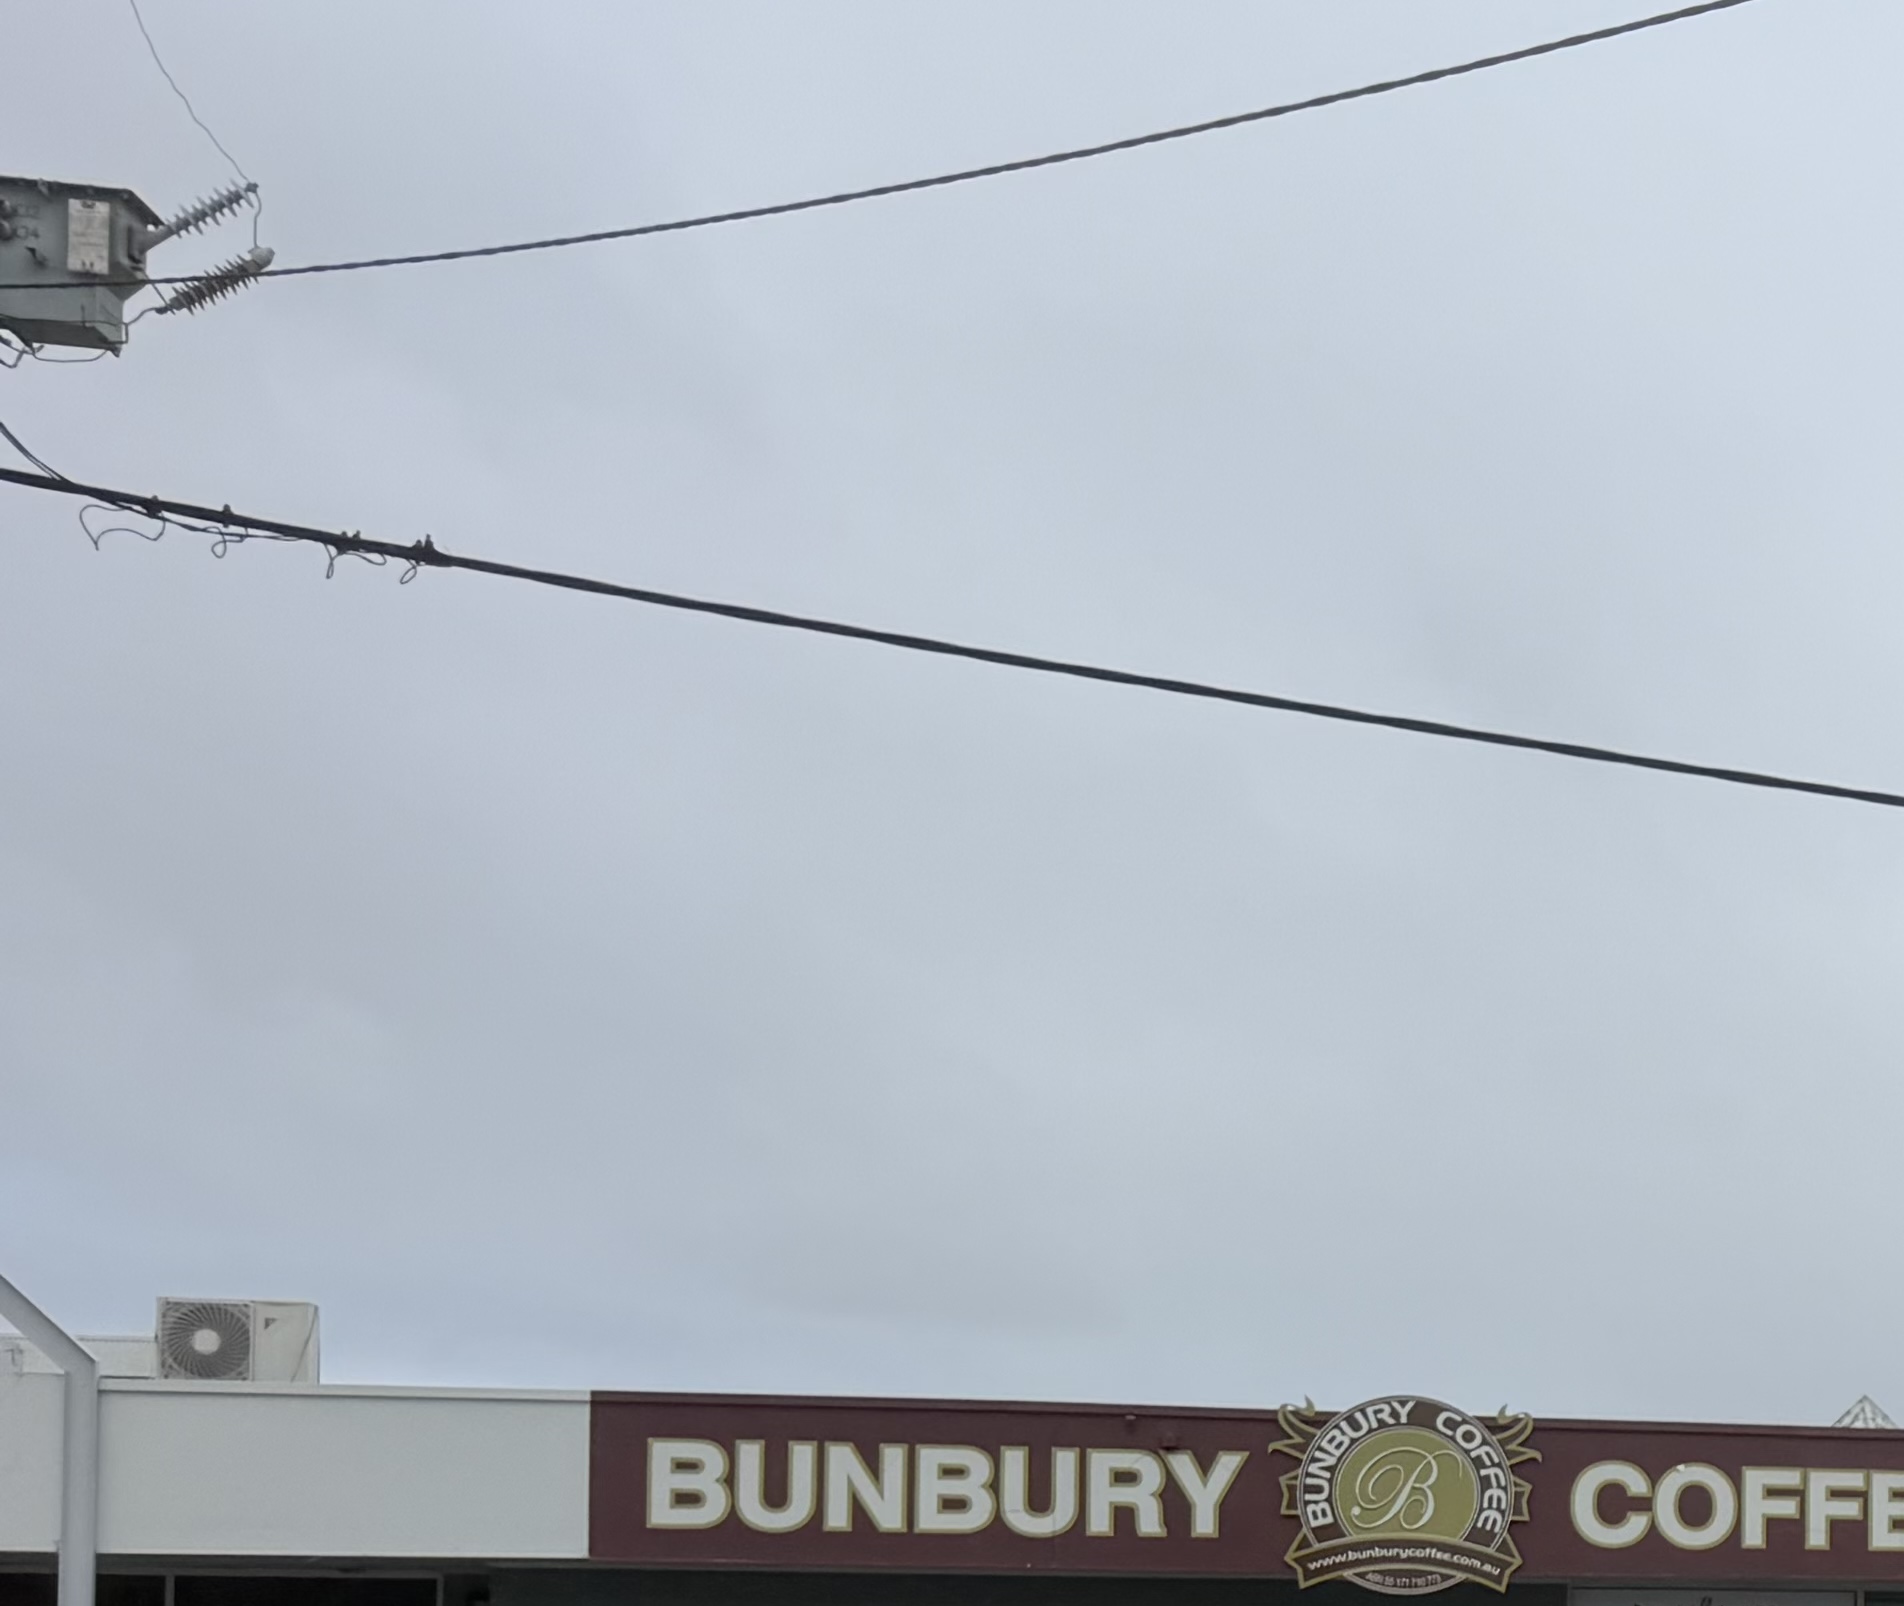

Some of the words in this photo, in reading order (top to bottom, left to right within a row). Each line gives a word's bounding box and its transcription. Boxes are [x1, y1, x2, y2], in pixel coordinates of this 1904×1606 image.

[646, 1437, 1249, 1538] BUNBURY
[1304, 1400, 1416, 1528] BUNBURY
[1436, 1411, 1506, 1533] COFFEE
[1307, 1547, 1501, 1575] www.bunburycoffee.com.au
